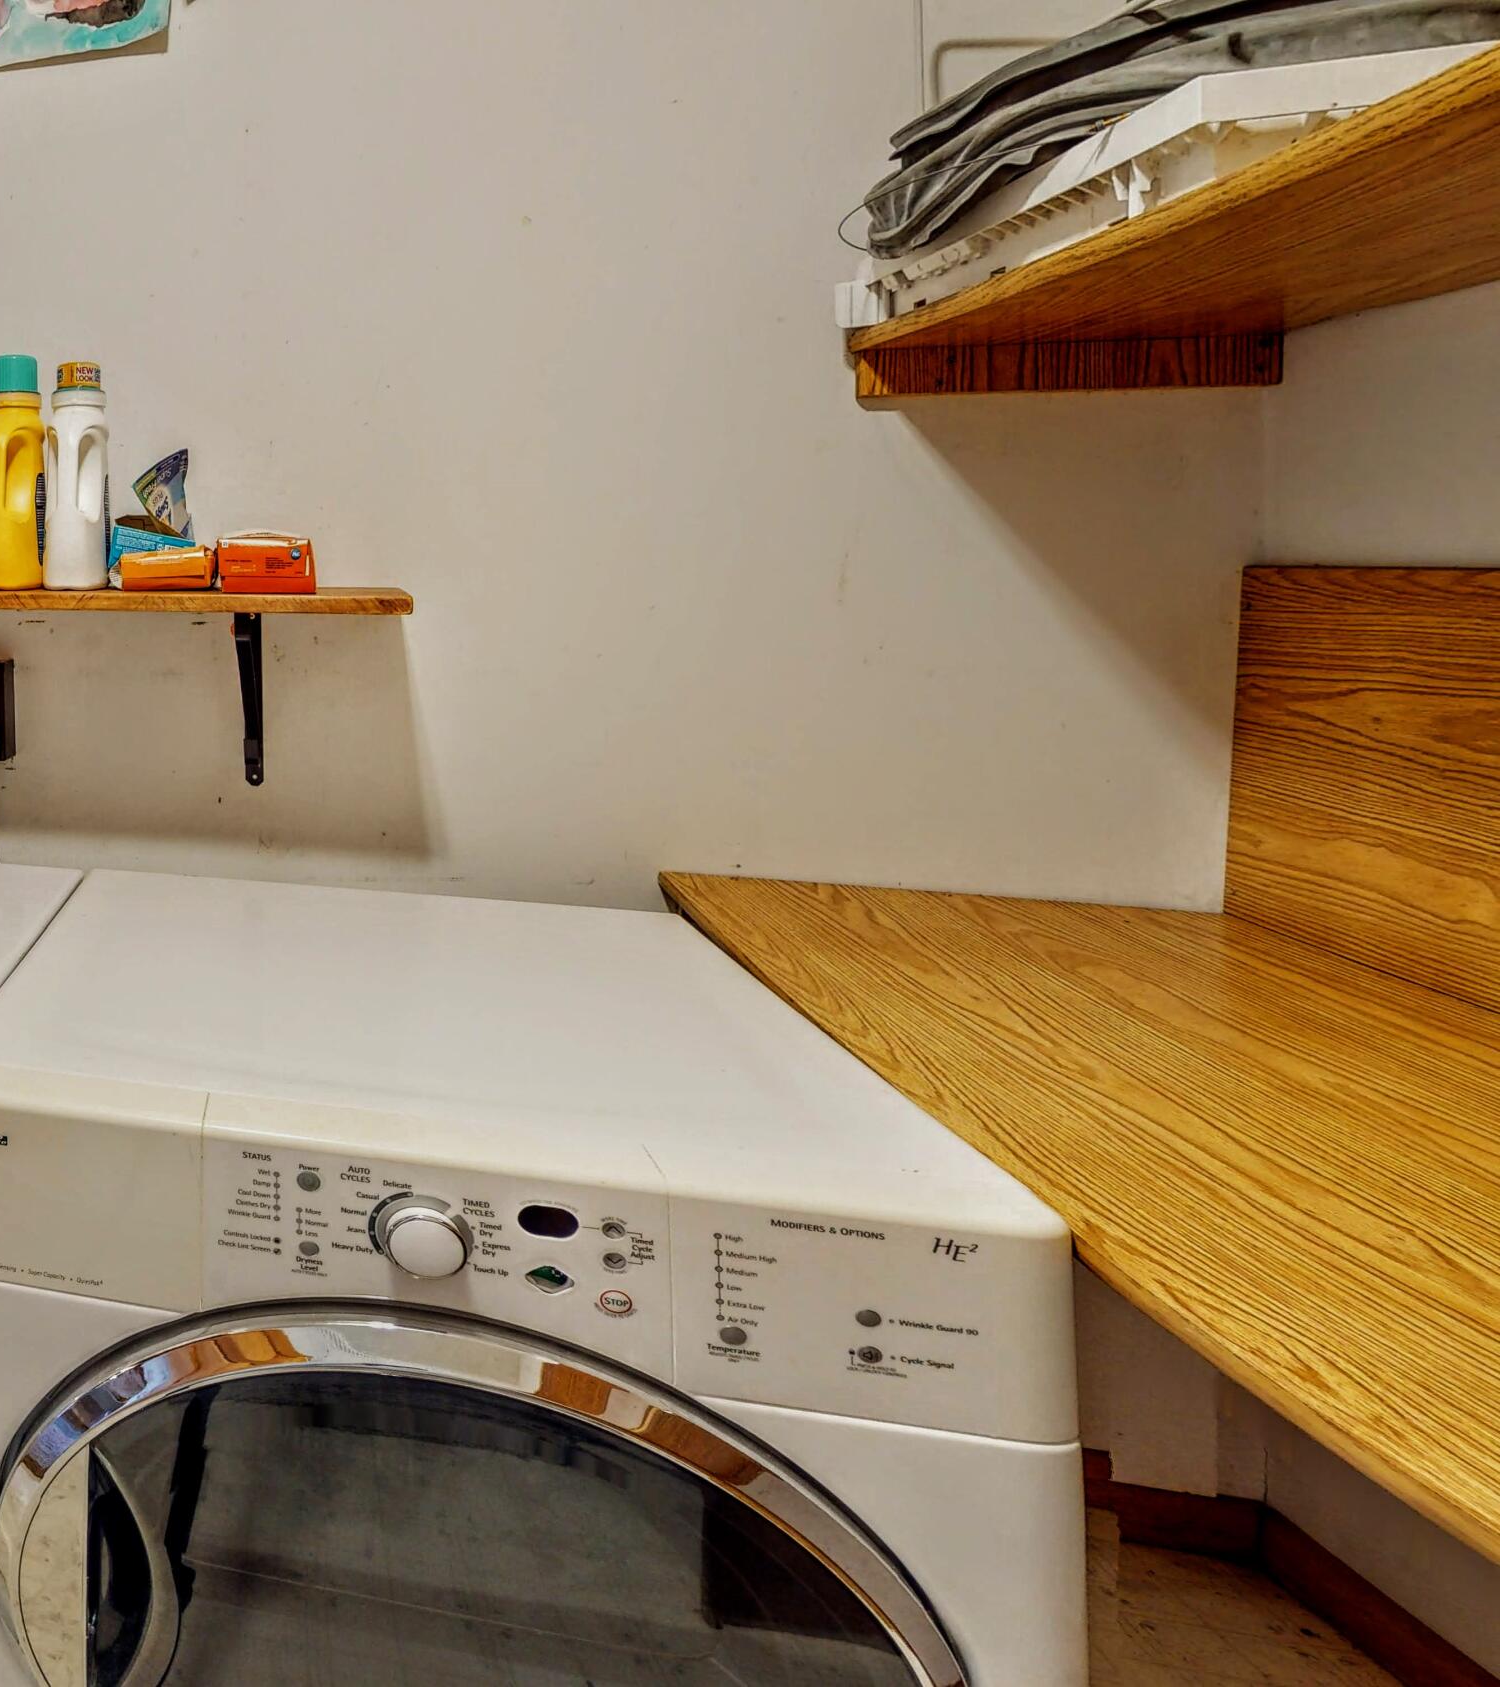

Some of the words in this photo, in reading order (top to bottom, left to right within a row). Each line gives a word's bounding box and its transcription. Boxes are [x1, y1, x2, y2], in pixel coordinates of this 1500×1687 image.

[75, 366, 94, 375] NEW
[242, 1151, 272, 1162] STATUS
[257, 1168, 271, 1176] Wet
[298, 1163, 320, 1172] Power
[347, 1165, 371, 1175] AUTO
[252, 1179, 271, 1188] Damp
[340, 1173, 371, 1184] CYCLES
[382, 1180, 412, 1190] Delicate
[237, 1188, 252, 1196] Cool
[253, 1191, 271, 1199] Down
[356, 1191, 380, 1200] Casual
[235, 1199, 259, 1208] Clothes
[259, 1201, 271, 1210] Dry
[463, 1198, 490, 1209] TIMED
[227, 1208, 251, 1217] Wrinkle
[252, 1212, 271, 1220] Guard
[305, 1207, 322, 1216] More
[340, 1207, 367, 1217] Normal
[463, 1207, 495, 1218] CYCLES
[305, 1219, 329, 1228] Normal
[479, 1222, 503, 1231] Timed
[346, 1225, 366, 1234] Jeans
[479, 1229, 493, 1239] Dry
[770, 1219, 826, 1233] MODIFIERS
[829, 1226, 837, 1235] &
[840, 1227, 886, 1240] OPTIONS
[223, 1229, 249, 1238] Controls
[250, 1233, 271, 1242] Locked
[630, 1236, 654, 1246] Timed
[725, 1233, 743, 1243] High
[217, 1239, 236, 1248] Check
[250, 1244, 271, 1253] Screen
[331, 1241, 354, 1252] Heavy
[356, 1245, 374, 1255] Duty
[482, 1241, 511, 1252] Express
[632, 1244, 653, 1254] Cycle
[482, 1248, 496, 1258] Dry
[630, 1251, 655, 1261] Adjust
[725, 1251, 757, 1262] Medium
[759, 1255, 778, 1265] High
[295, 1255, 323, 1266] Dryness
[300, 1263, 319, 1272] Level
[473, 1264, 496, 1275] Touch
[498, 1269, 509, 1278] Up
[726, 1267, 758, 1278] Medium
[27, 1268, 42, 1277] Super
[43, 1271, 66, 1282] Capacity
[726, 1284, 742, 1292] Low
[604, 1297, 629, 1308] STOP
[727, 1300, 747, 1309] Extra
[749, 1303, 765, 1311] Low
[740, 1318, 758, 1328] Only
[898, 1319, 934, 1330] Wrinkle
[936, 1324, 964, 1335] Guard
[966, 1328, 979, 1336] 90
[707, 1343, 761, 1358] Temperature
[900, 1355, 925, 1366] Cycle
[927, 1359, 955, 1370] Signal
